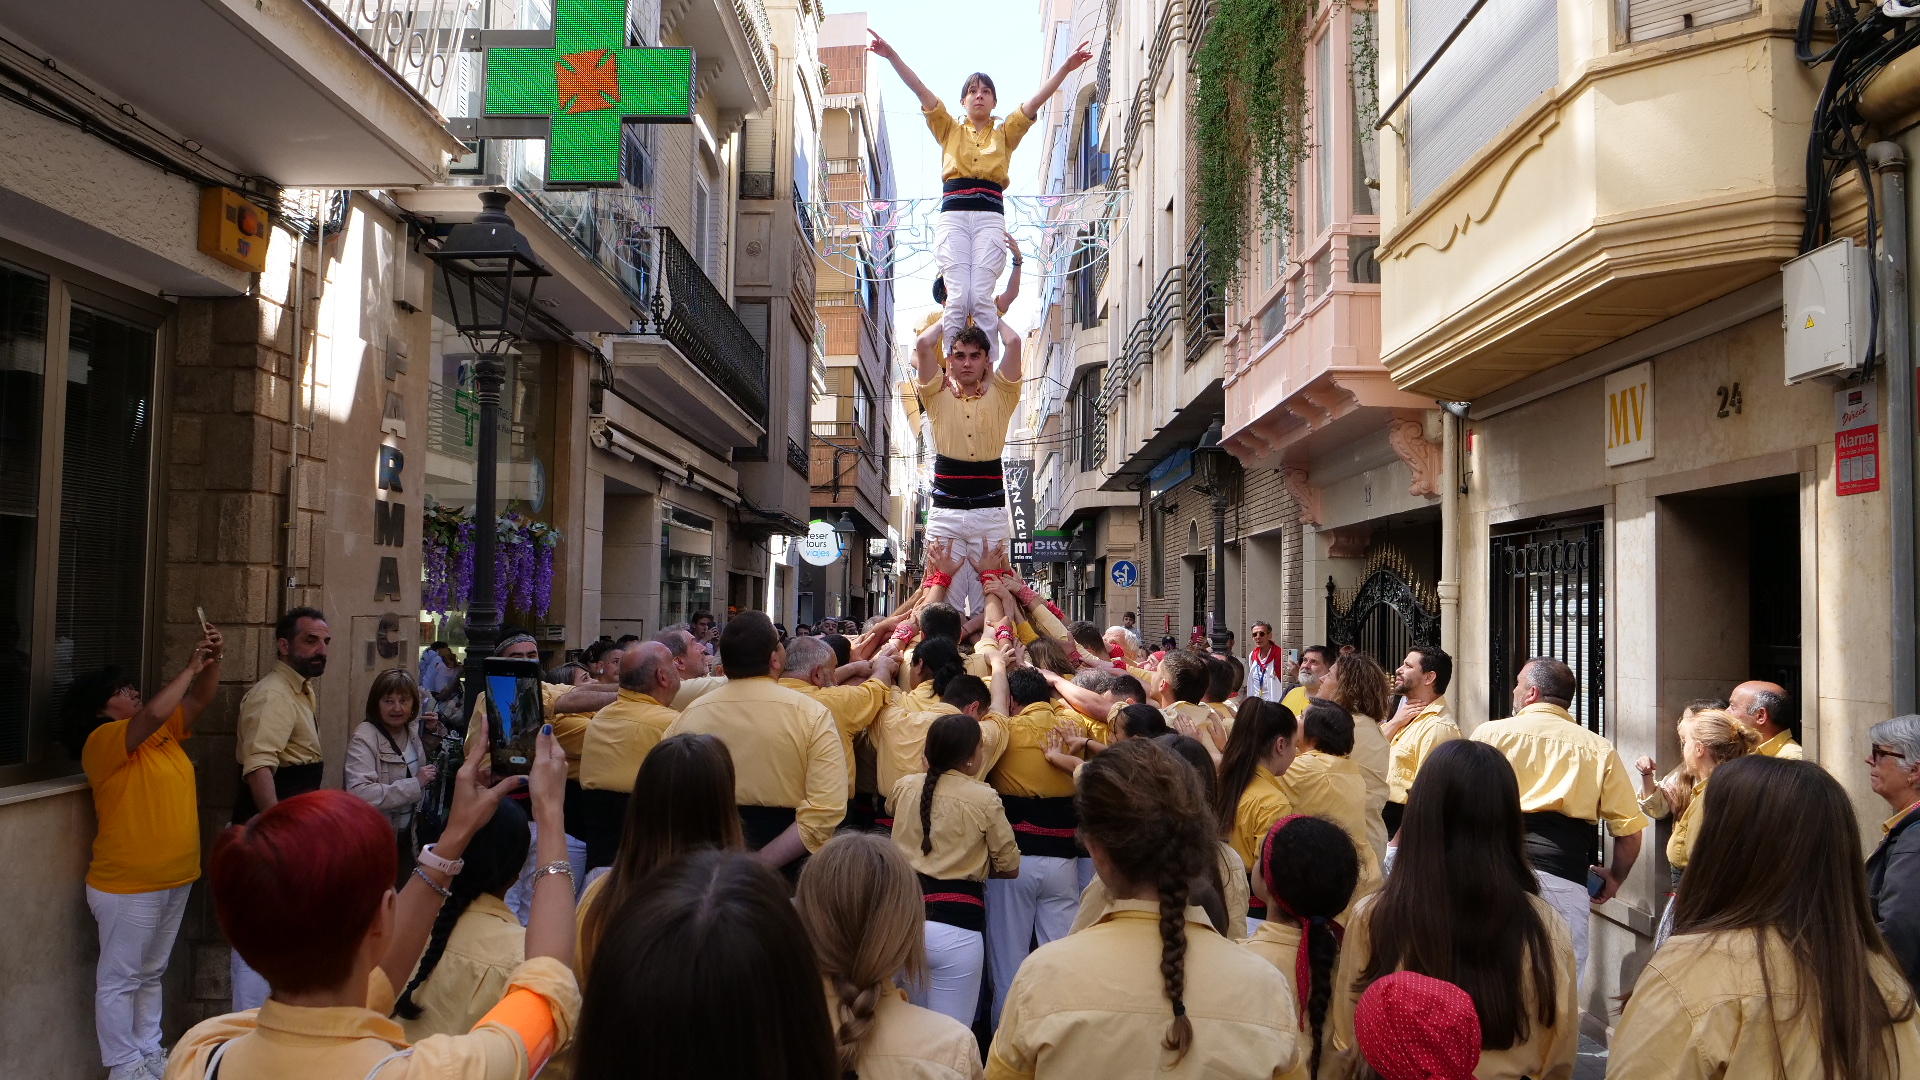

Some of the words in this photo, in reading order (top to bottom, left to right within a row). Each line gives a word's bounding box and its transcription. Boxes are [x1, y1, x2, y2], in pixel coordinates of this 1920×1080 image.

[1717, 381, 1743, 418] 24
[1608, 383, 1647, 449] MV
[1842, 402, 1870, 426] Direct
[1839, 432, 1875, 449] Alarma
[806, 540, 827, 548] tours
[1034, 540, 1069, 550] DKV
[805, 549, 830, 558] viajes
